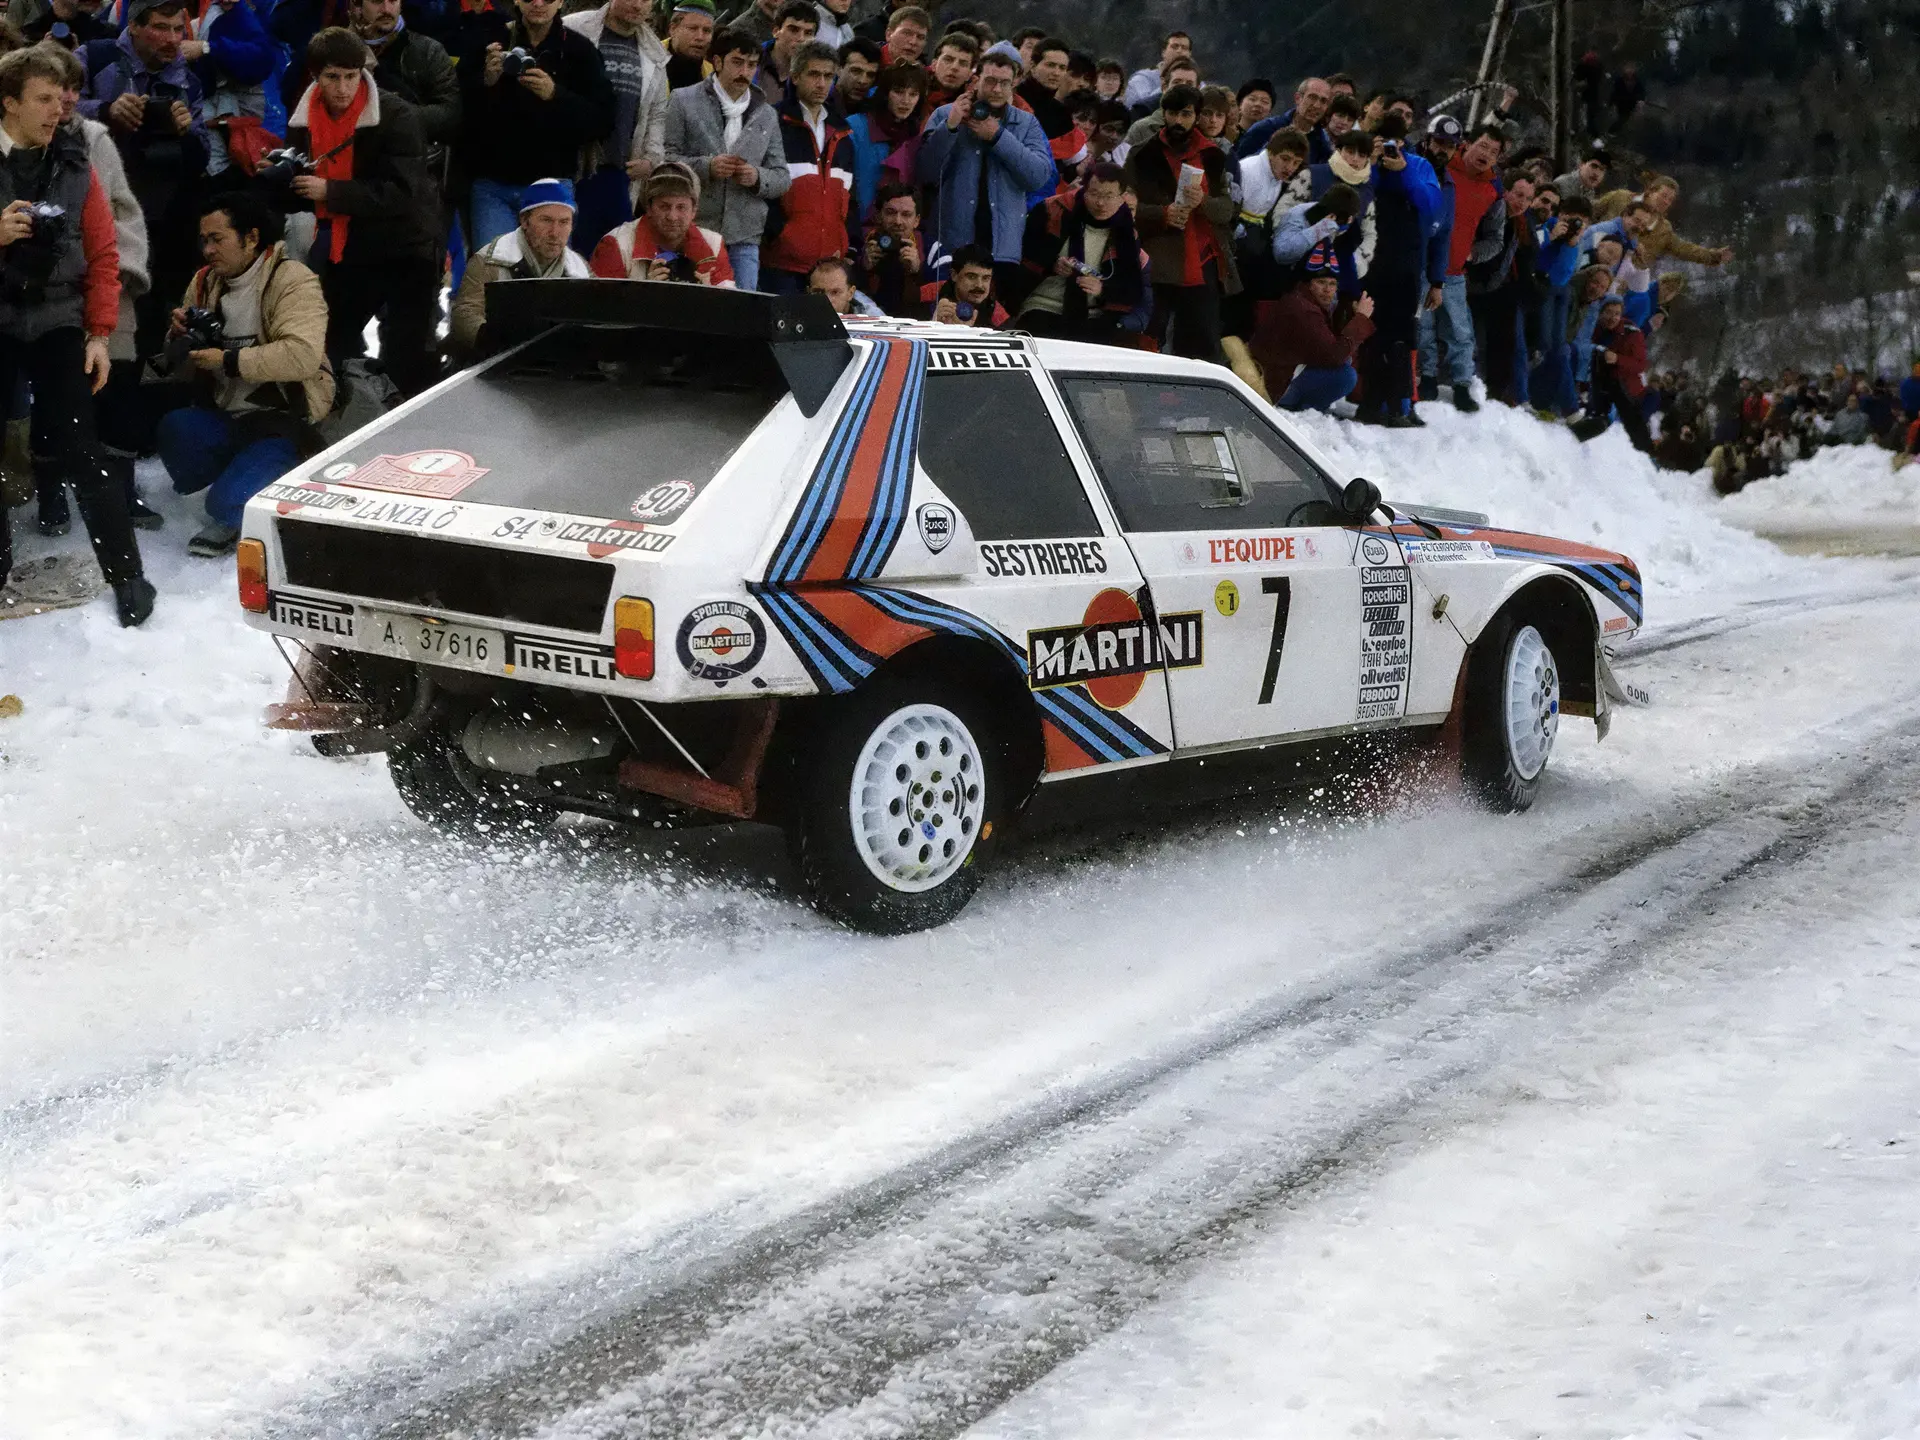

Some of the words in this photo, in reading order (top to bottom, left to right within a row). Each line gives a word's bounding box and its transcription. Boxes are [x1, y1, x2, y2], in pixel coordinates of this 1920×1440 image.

[639, 485, 687, 513] 90
[560, 523, 673, 551] MARTINI
[980, 541, 1108, 577] SESTRIERES
[270, 589, 354, 637] PIRELLI
[420, 627, 489, 661] 37616
[505, 631, 616, 681] PIRELLI
[1034, 620, 1197, 680] MARTINI
[1257, 575, 1292, 705] 7
